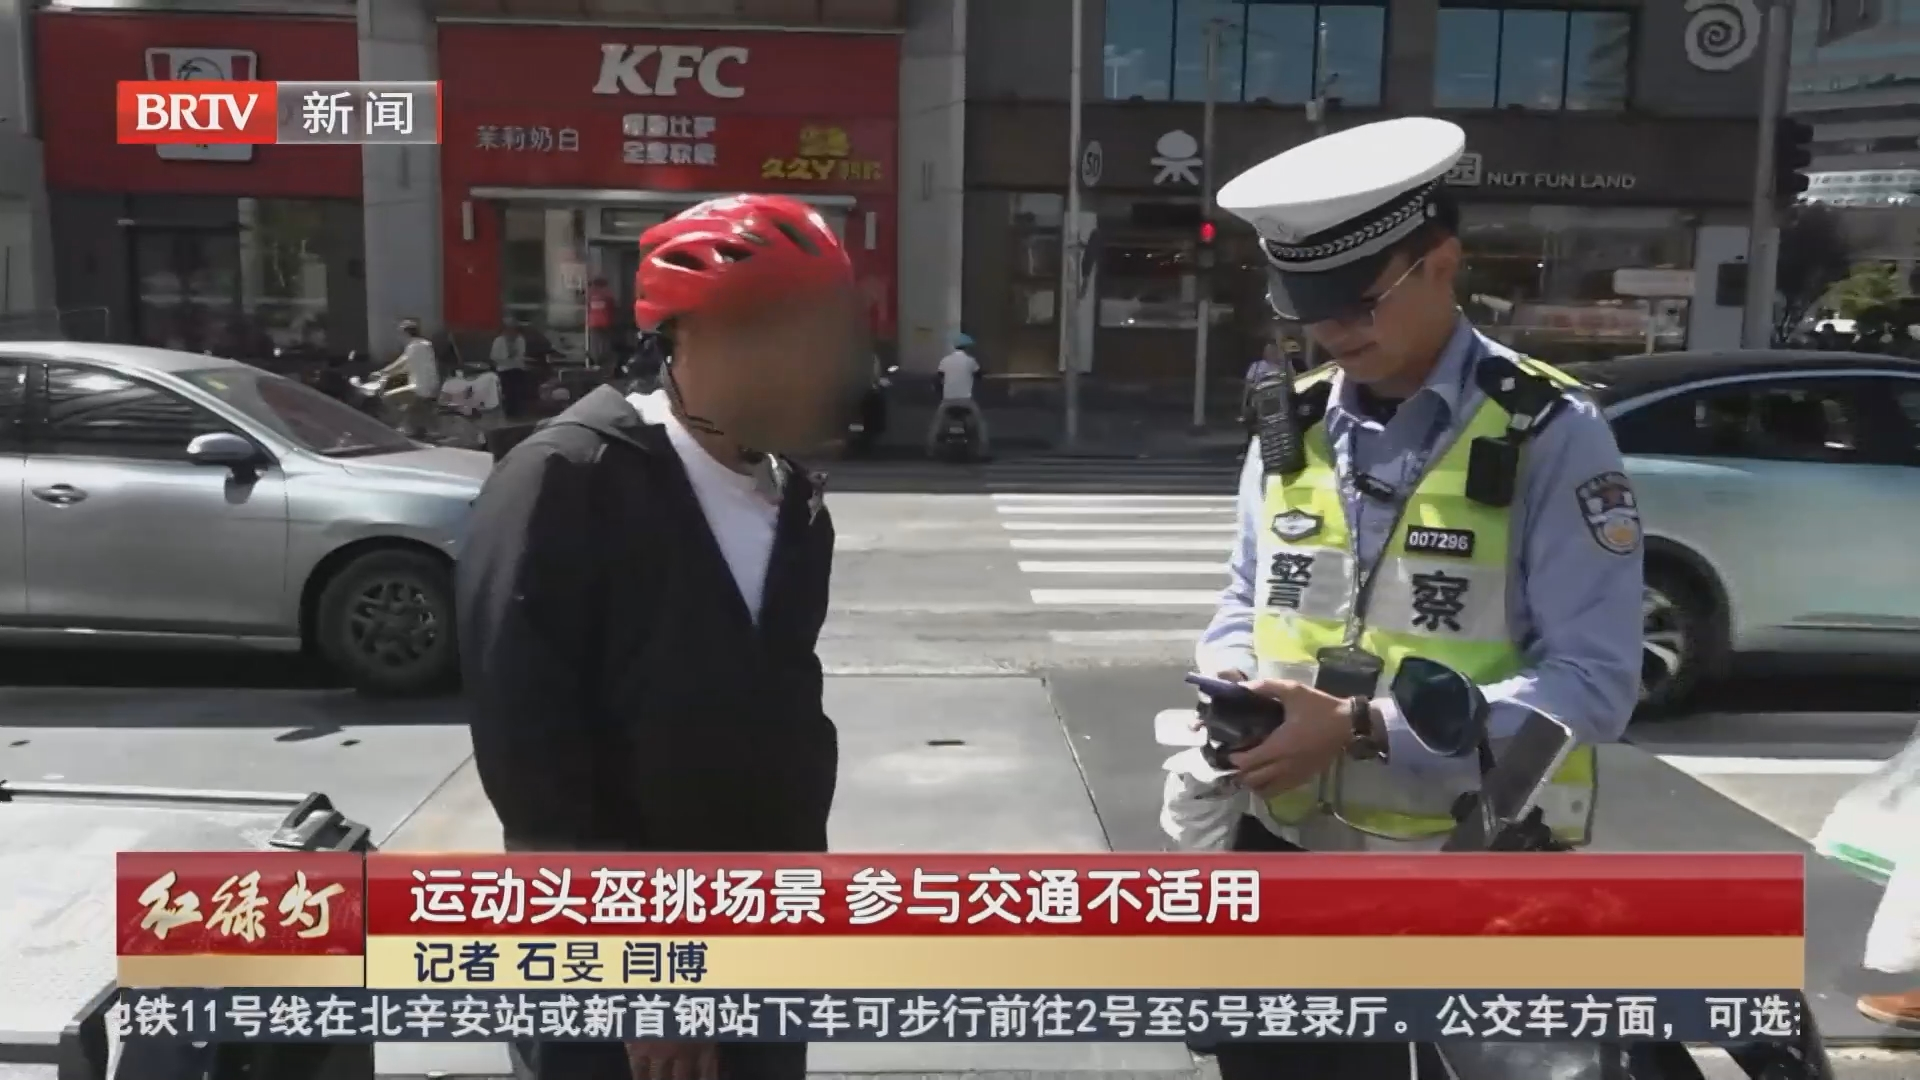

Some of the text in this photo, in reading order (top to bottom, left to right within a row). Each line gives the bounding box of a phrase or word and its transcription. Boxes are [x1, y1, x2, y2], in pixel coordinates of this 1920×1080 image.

[592, 43, 749, 98] KFC
[475, 125, 580, 152] 茉莉奶白
[1487, 172, 1636, 189] NUT FUN LAND
[1409, 531, 1468, 550] 007296
[1266, 552, 1469, 632] 警 察
